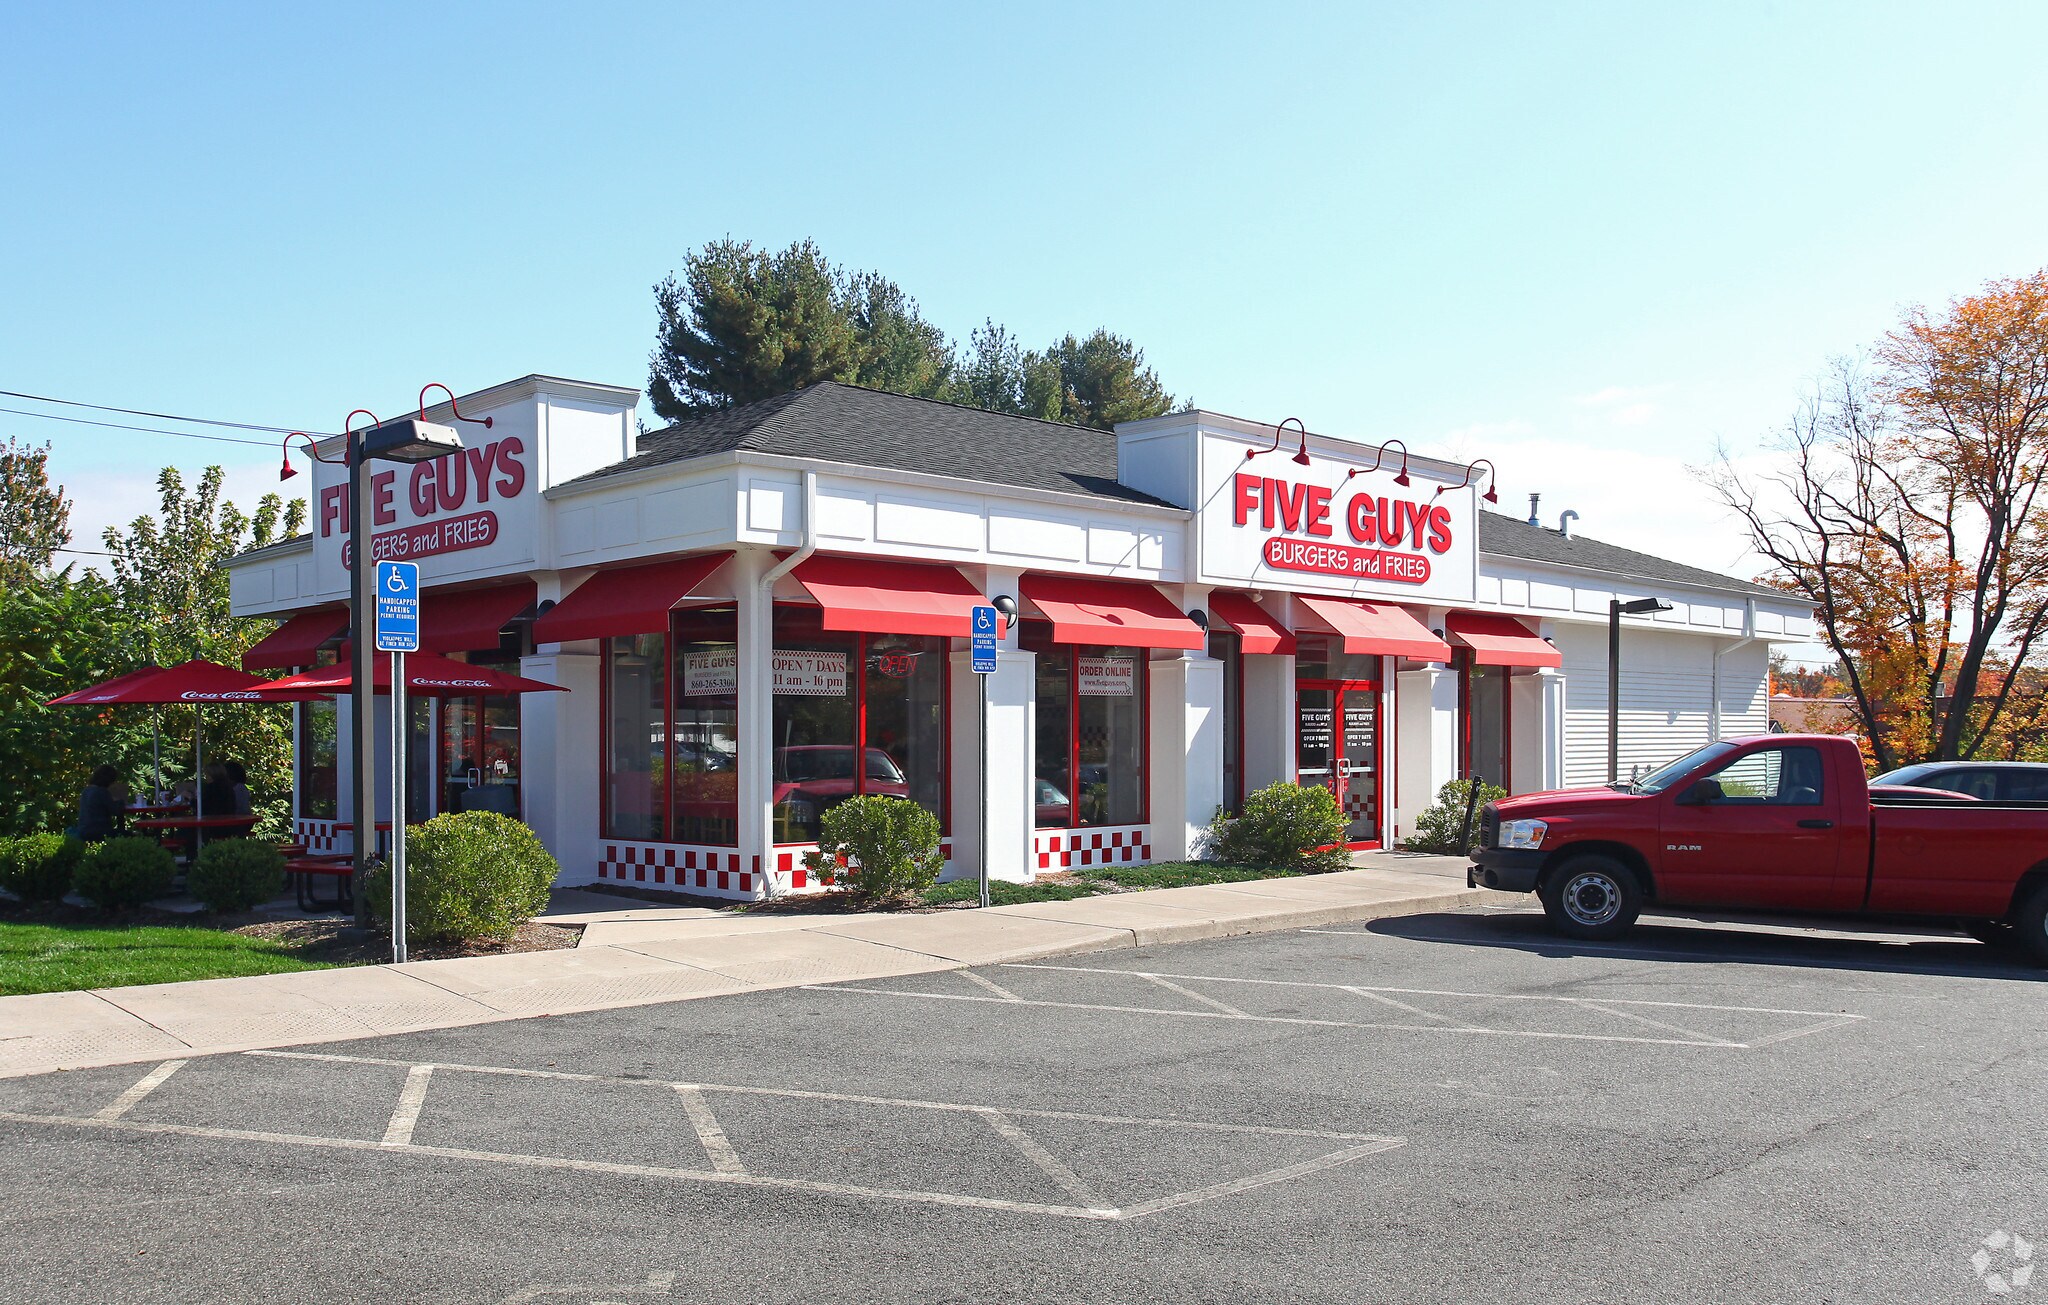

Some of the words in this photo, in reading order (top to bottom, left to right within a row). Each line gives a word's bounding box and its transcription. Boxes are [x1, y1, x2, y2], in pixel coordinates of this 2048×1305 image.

[321, 470, 396, 538] FIE
[409, 437, 525, 517] GUYS
[1234, 473, 1333, 537] FIVE
[1347, 492, 1453, 554] GUYS
[413, 526, 439, 552] and
[444, 516, 490, 547] FRIES
[1271, 541, 1349, 570] BURGERS
[1353, 551, 1381, 574] and
[1385, 555, 1427, 579] FRIES
[379, 597, 416, 606] HANDICAPPED
[386, 605, 410, 613] PARKING
[689, 658, 709, 670] FIVE
[711, 656, 736, 669] GUYS
[772, 657, 803, 671] OPEN
[806, 659, 813, 671] 7
[817, 660, 845, 673] DAYS
[879, 655, 918, 673] OPEN
[1080, 666, 1104, 676] ORDER
[1105, 667, 1132, 677] ONLINE
[412, 677, 492, 687] Coca-Cola
[690, 678, 735, 689] 860-265-3300
[773, 673, 783, 685] 11
[786, 676, 802, 686] am
[827, 678, 843, 690] pm
[180, 690, 263, 700] Coca-Cola
[1301, 713, 1315, 721] FIVE
[1315, 713, 1331, 721] GUYS
[1345, 713, 1358, 721] FIVE
[1358, 713, 1373, 721] GUYS
